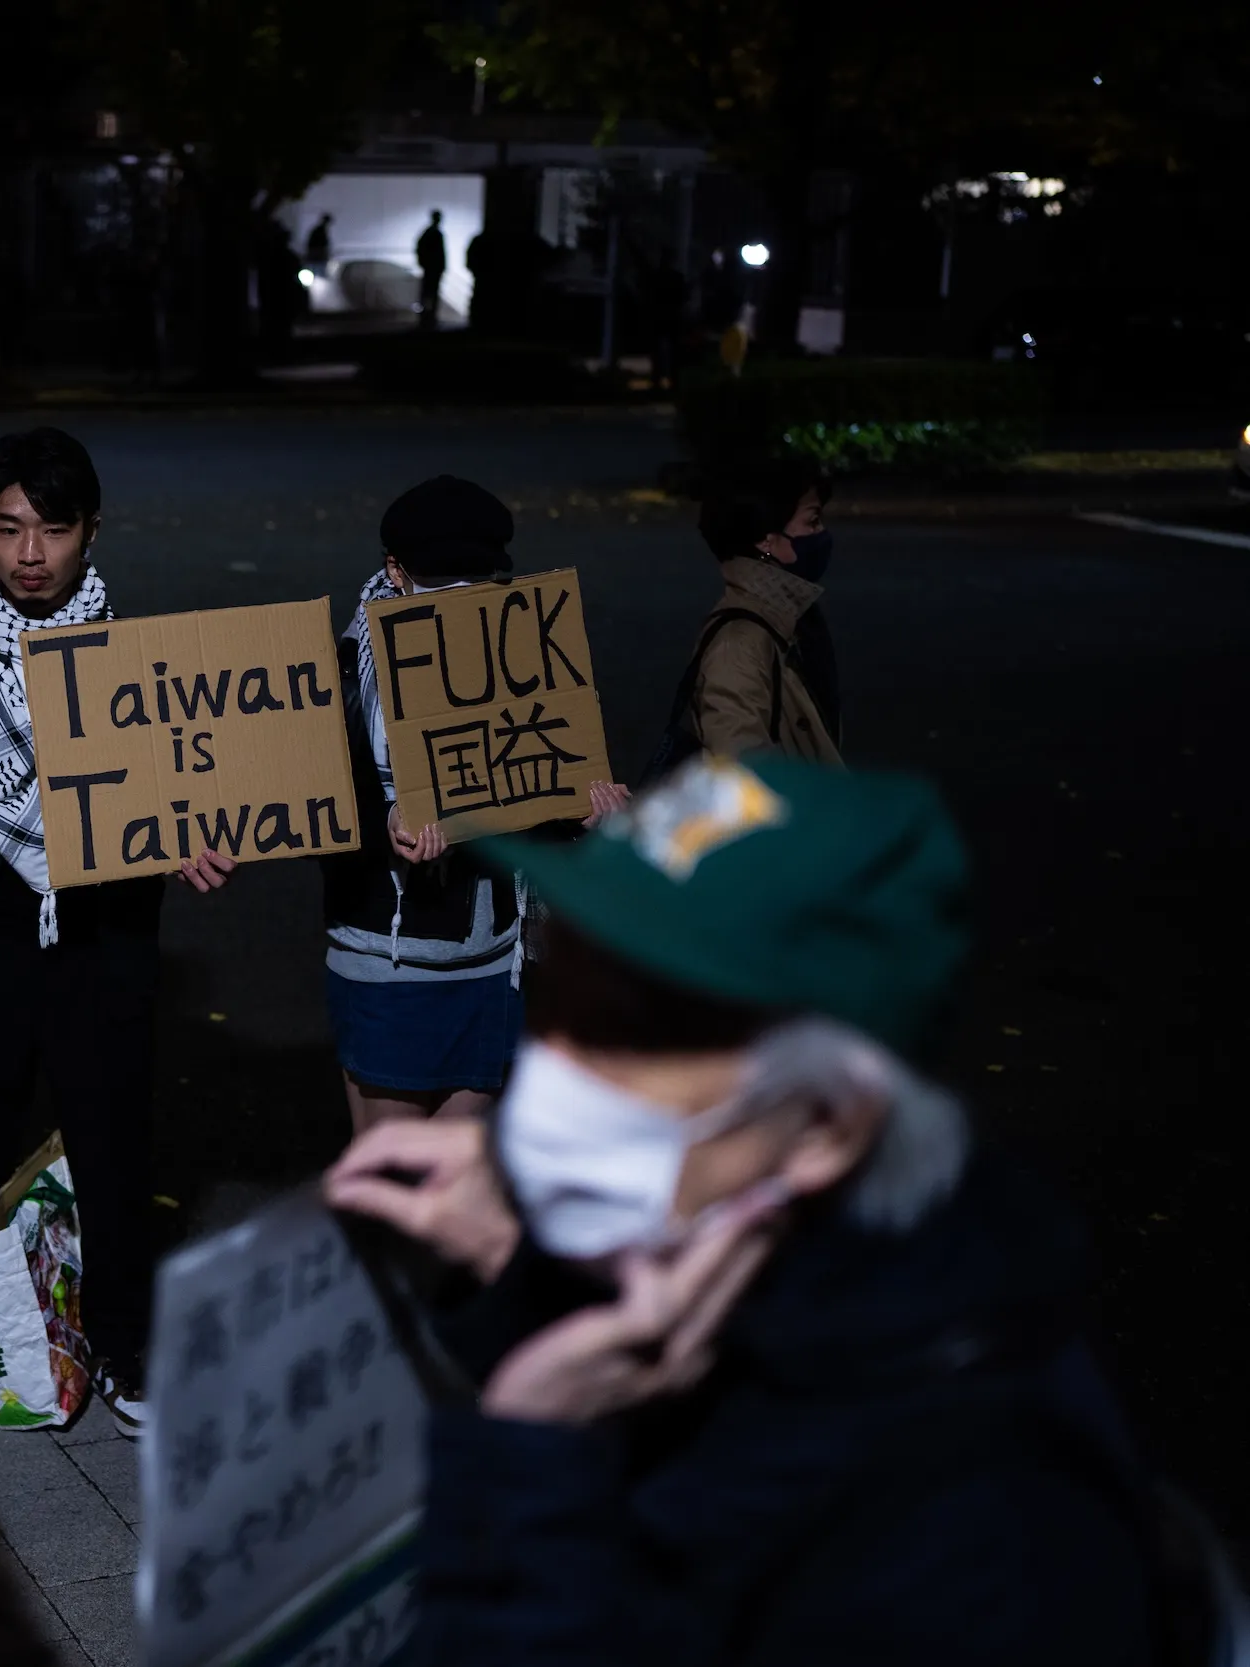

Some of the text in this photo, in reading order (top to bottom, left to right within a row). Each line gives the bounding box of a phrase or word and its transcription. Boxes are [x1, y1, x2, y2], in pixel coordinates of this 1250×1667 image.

[28, 630, 332, 738] Taiwan
[380, 587, 587, 720] FUCK
[171, 727, 215, 772] is
[422, 702, 587, 820] 国益
[48, 769, 351, 870] Taiwan
